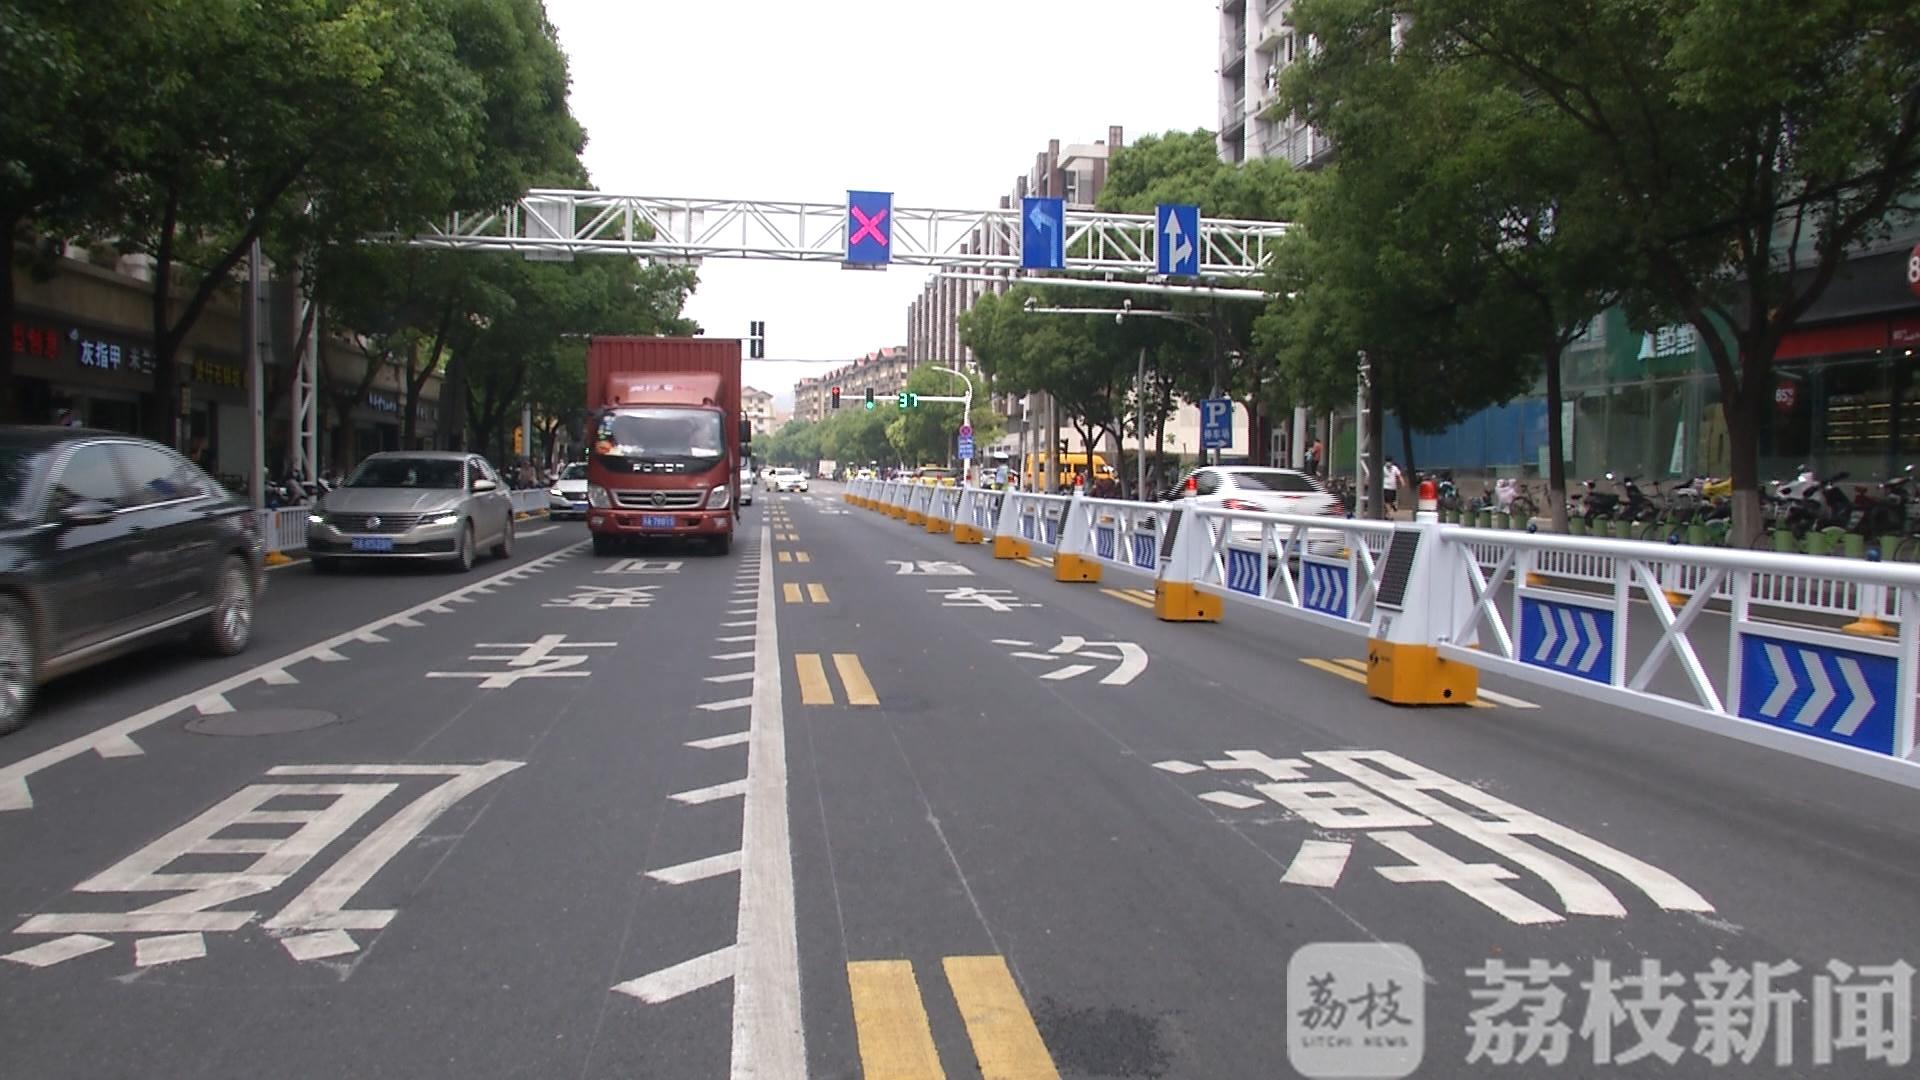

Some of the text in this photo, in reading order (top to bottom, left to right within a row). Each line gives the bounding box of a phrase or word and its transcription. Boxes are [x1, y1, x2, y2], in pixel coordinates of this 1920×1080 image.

[1908, 256, 1920, 283] 8
[80, 339, 122, 369] 灰指甲
[899, 392, 918, 407] 37
[1206, 402, 1226, 428] P
